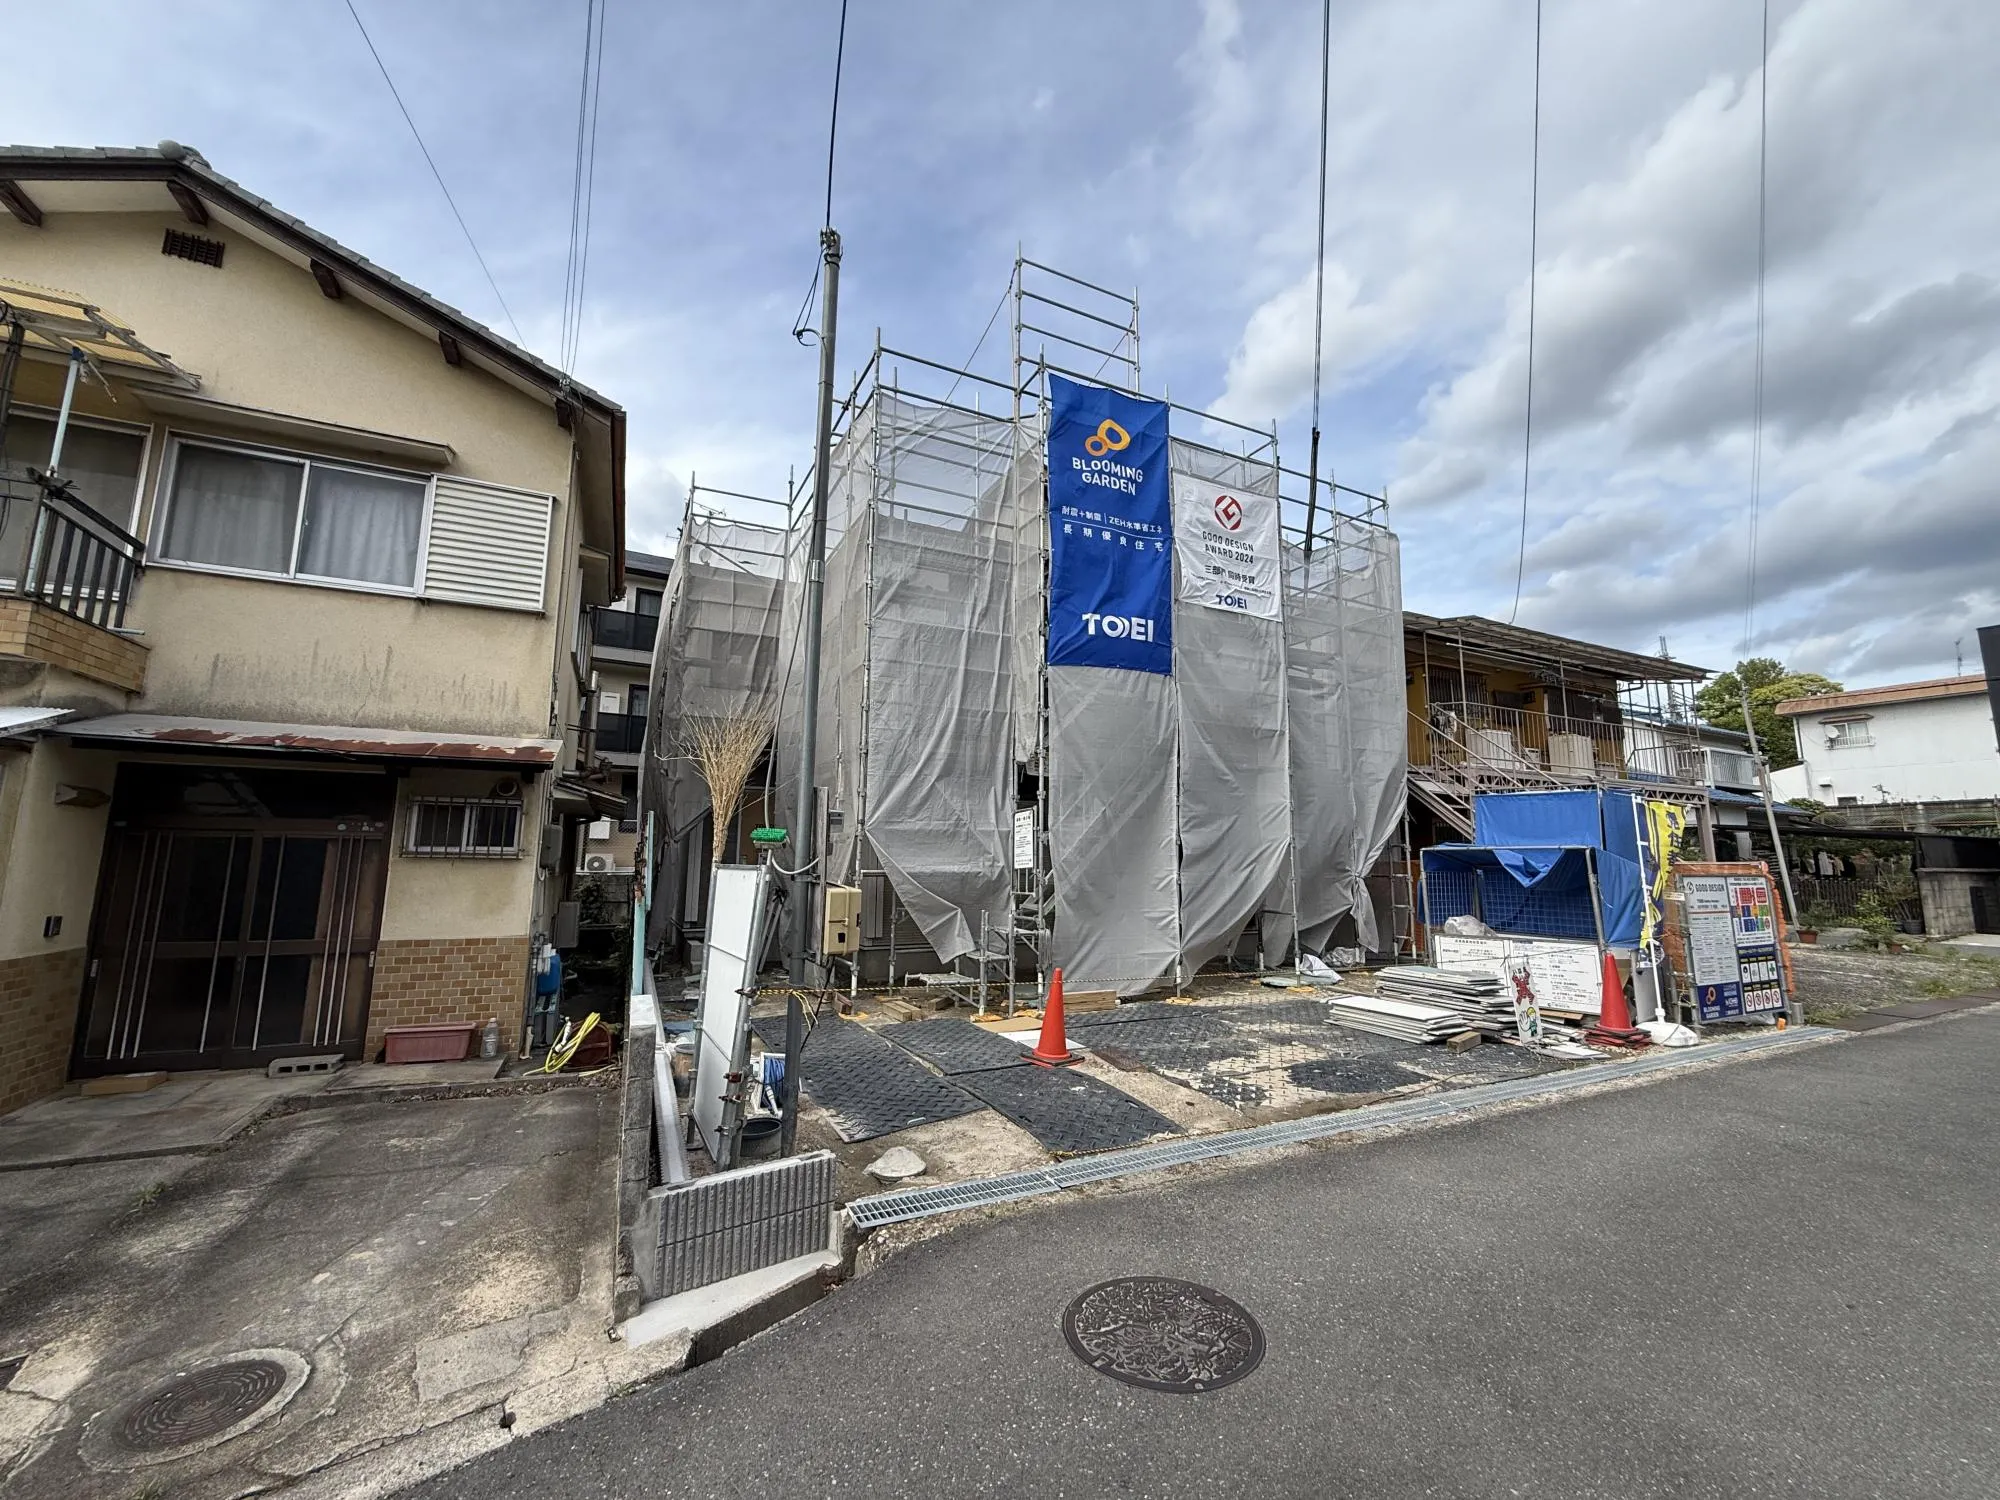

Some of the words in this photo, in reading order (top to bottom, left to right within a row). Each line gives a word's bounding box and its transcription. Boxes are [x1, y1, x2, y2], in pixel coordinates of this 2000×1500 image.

[1072, 457, 1143, 482] BLOOMING
[1082, 473, 1136, 496] GARDEN
[1064, 524, 1163, 551] 長期優良住宅
[1203, 531, 1223, 545] GOOD
[1225, 538, 1254, 552] DESIGN
[1205, 544, 1233, 559] AWARD
[1235, 552, 1254, 564] 2024
[1216, 594, 1247, 609] TOEI
[1082, 613, 1154, 642] TOEI
